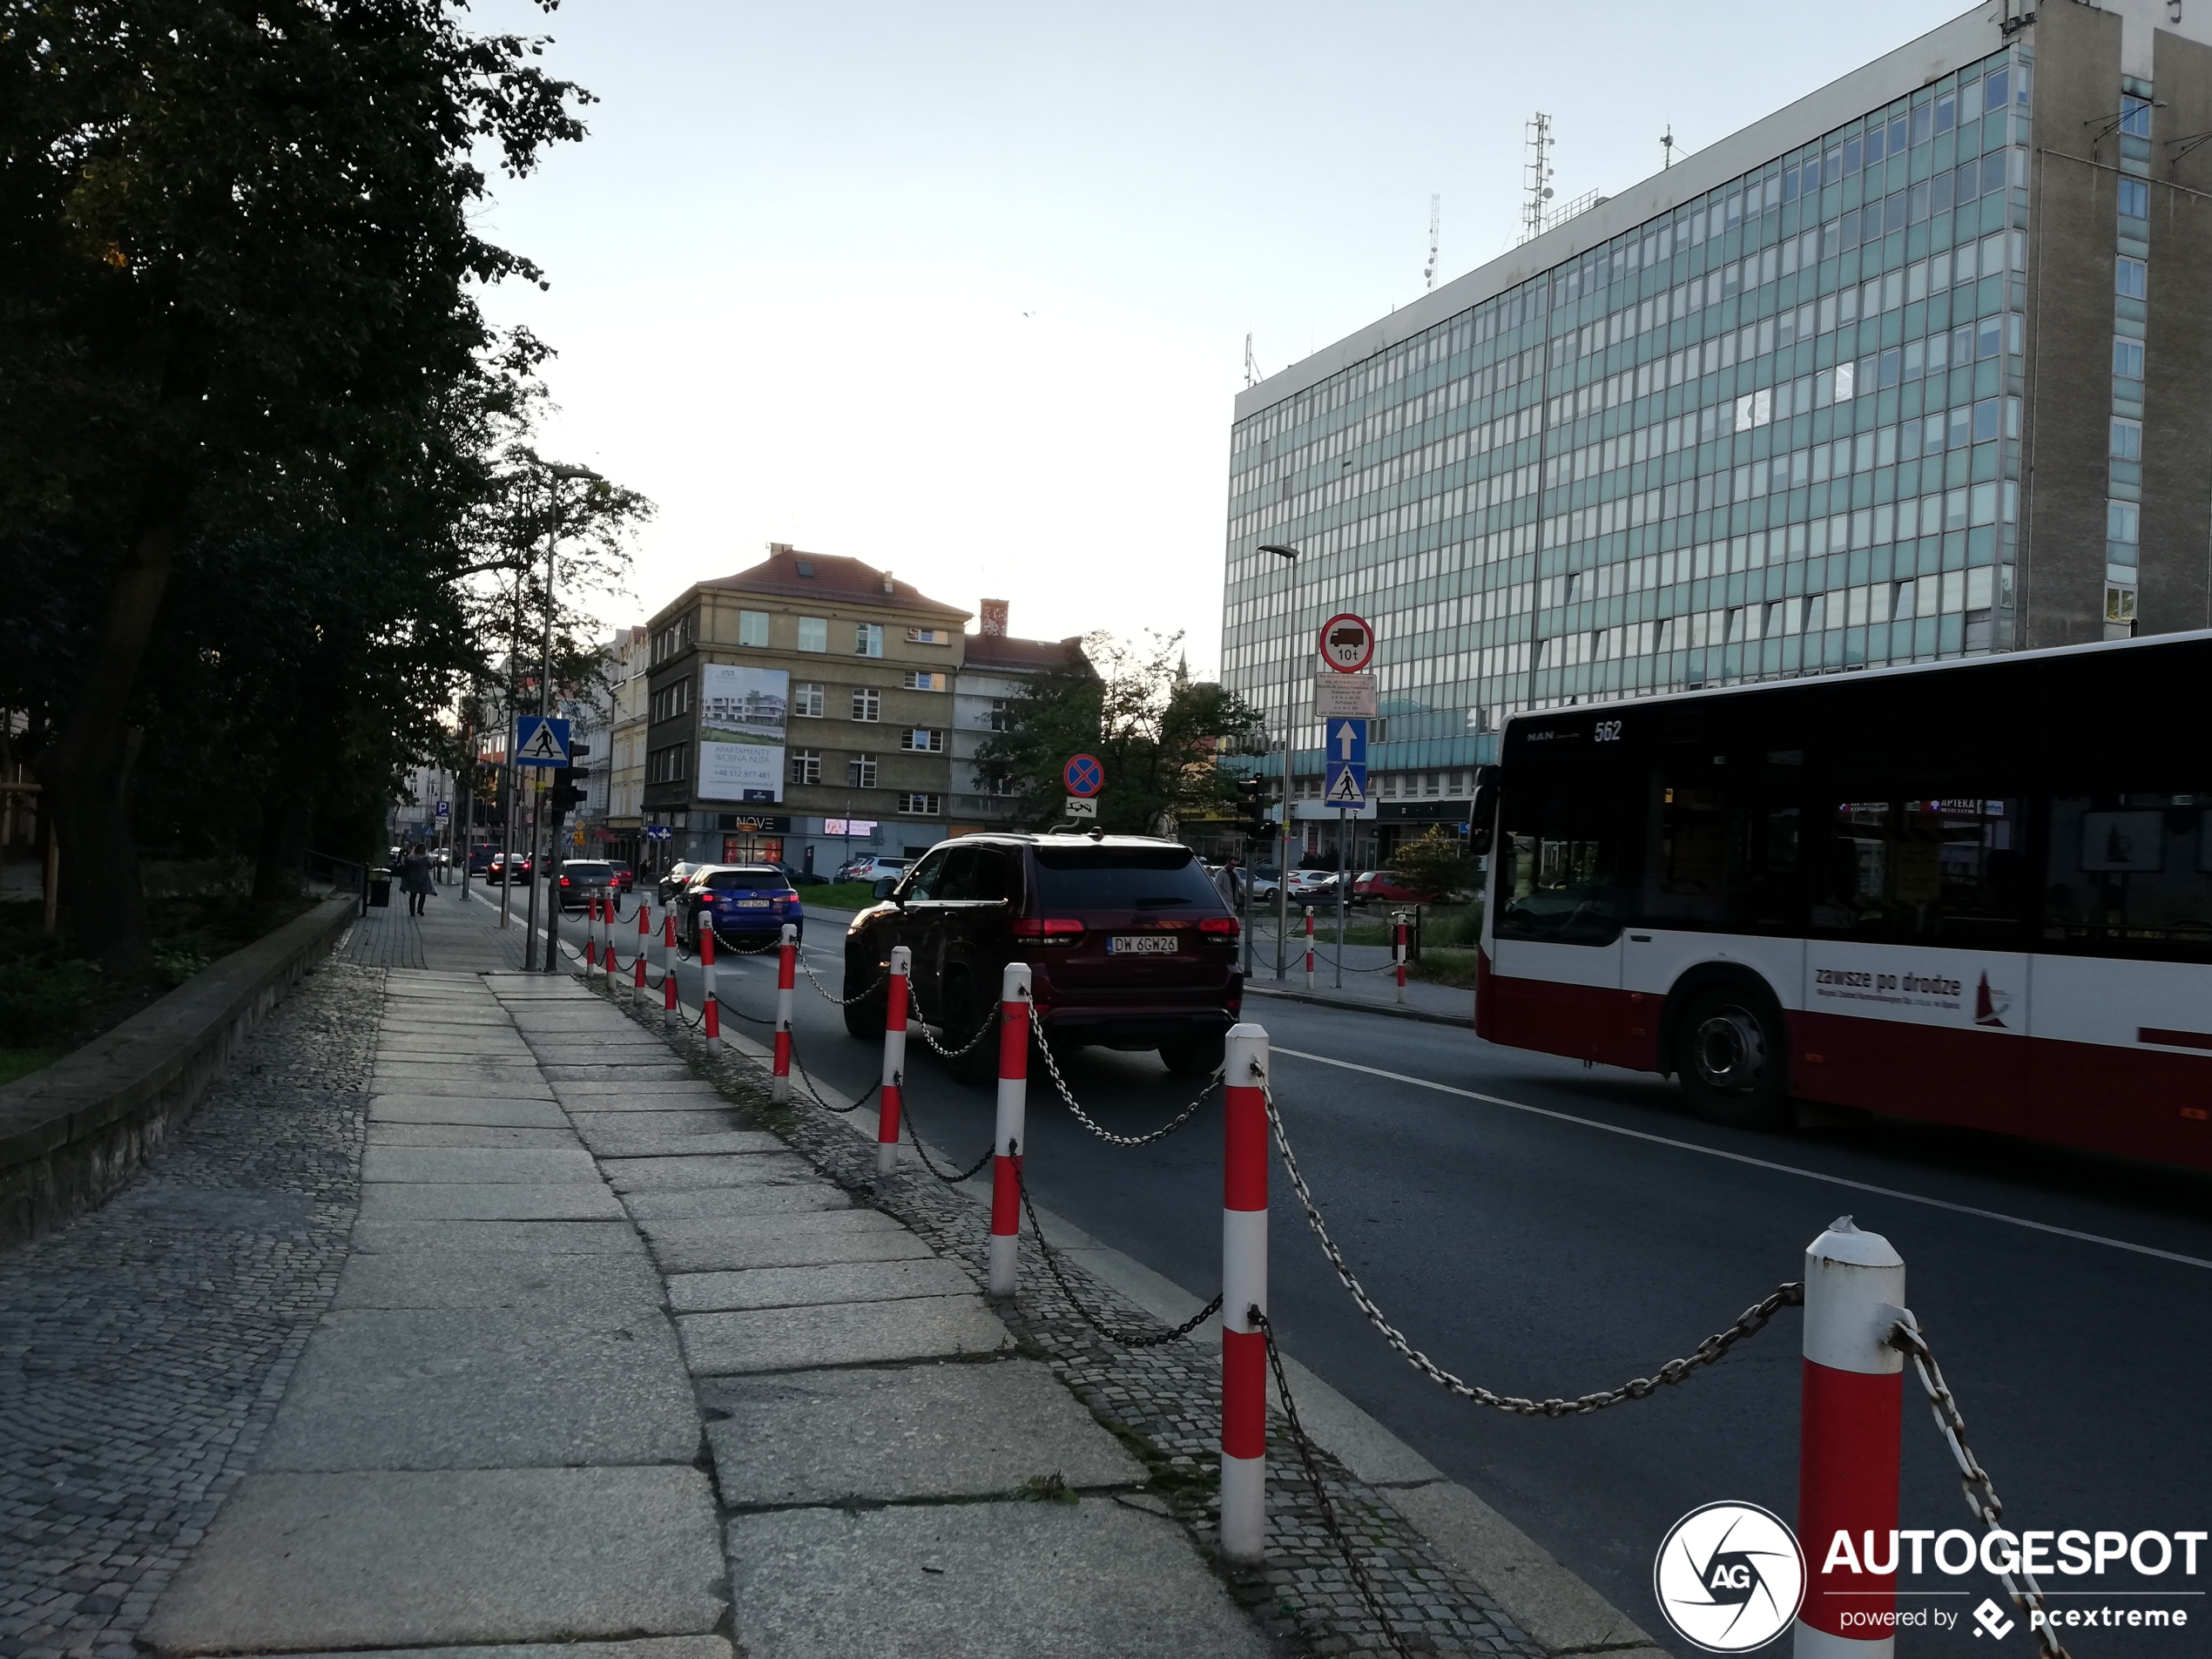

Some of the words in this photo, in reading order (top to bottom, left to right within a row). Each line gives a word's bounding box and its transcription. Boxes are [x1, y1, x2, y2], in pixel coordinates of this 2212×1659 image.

[1339, 649, 1359, 661] 10t
[1527, 732, 1554, 741] MAN
[1595, 720, 1622, 742] 562
[715, 746, 771, 756] APARTAMENTY
[715, 753, 747, 763] WODNA
[749, 756, 771, 765] NUTA
[1941, 799, 1974, 808] APTEKA
[1116, 938, 1132, 951] DW
[1137, 937, 1175, 951] 6GW26
[1816, 968, 1871, 988] zawsze
[1876, 974, 1897, 994] po
[1902, 972, 1961, 996] drodze
